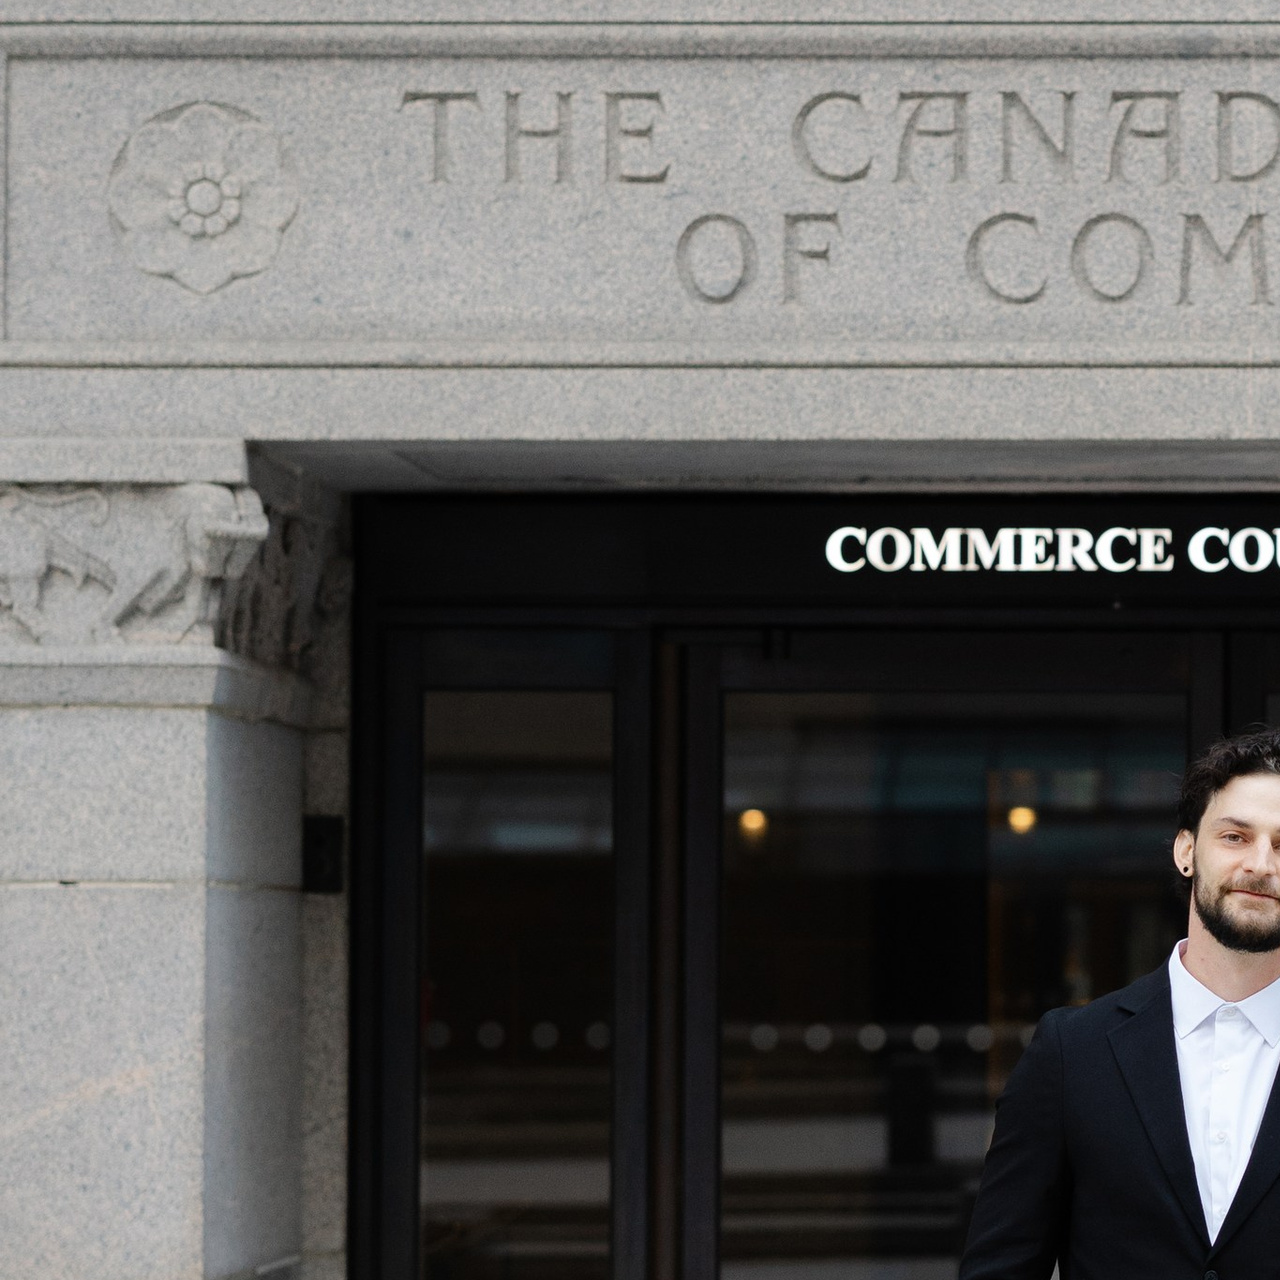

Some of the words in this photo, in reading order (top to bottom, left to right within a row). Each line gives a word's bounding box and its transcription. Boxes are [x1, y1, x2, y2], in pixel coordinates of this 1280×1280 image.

[399, 90, 672, 184] THE
[675, 212, 843, 305] OF
[825, 525, 1175, 572] COMMERCE
